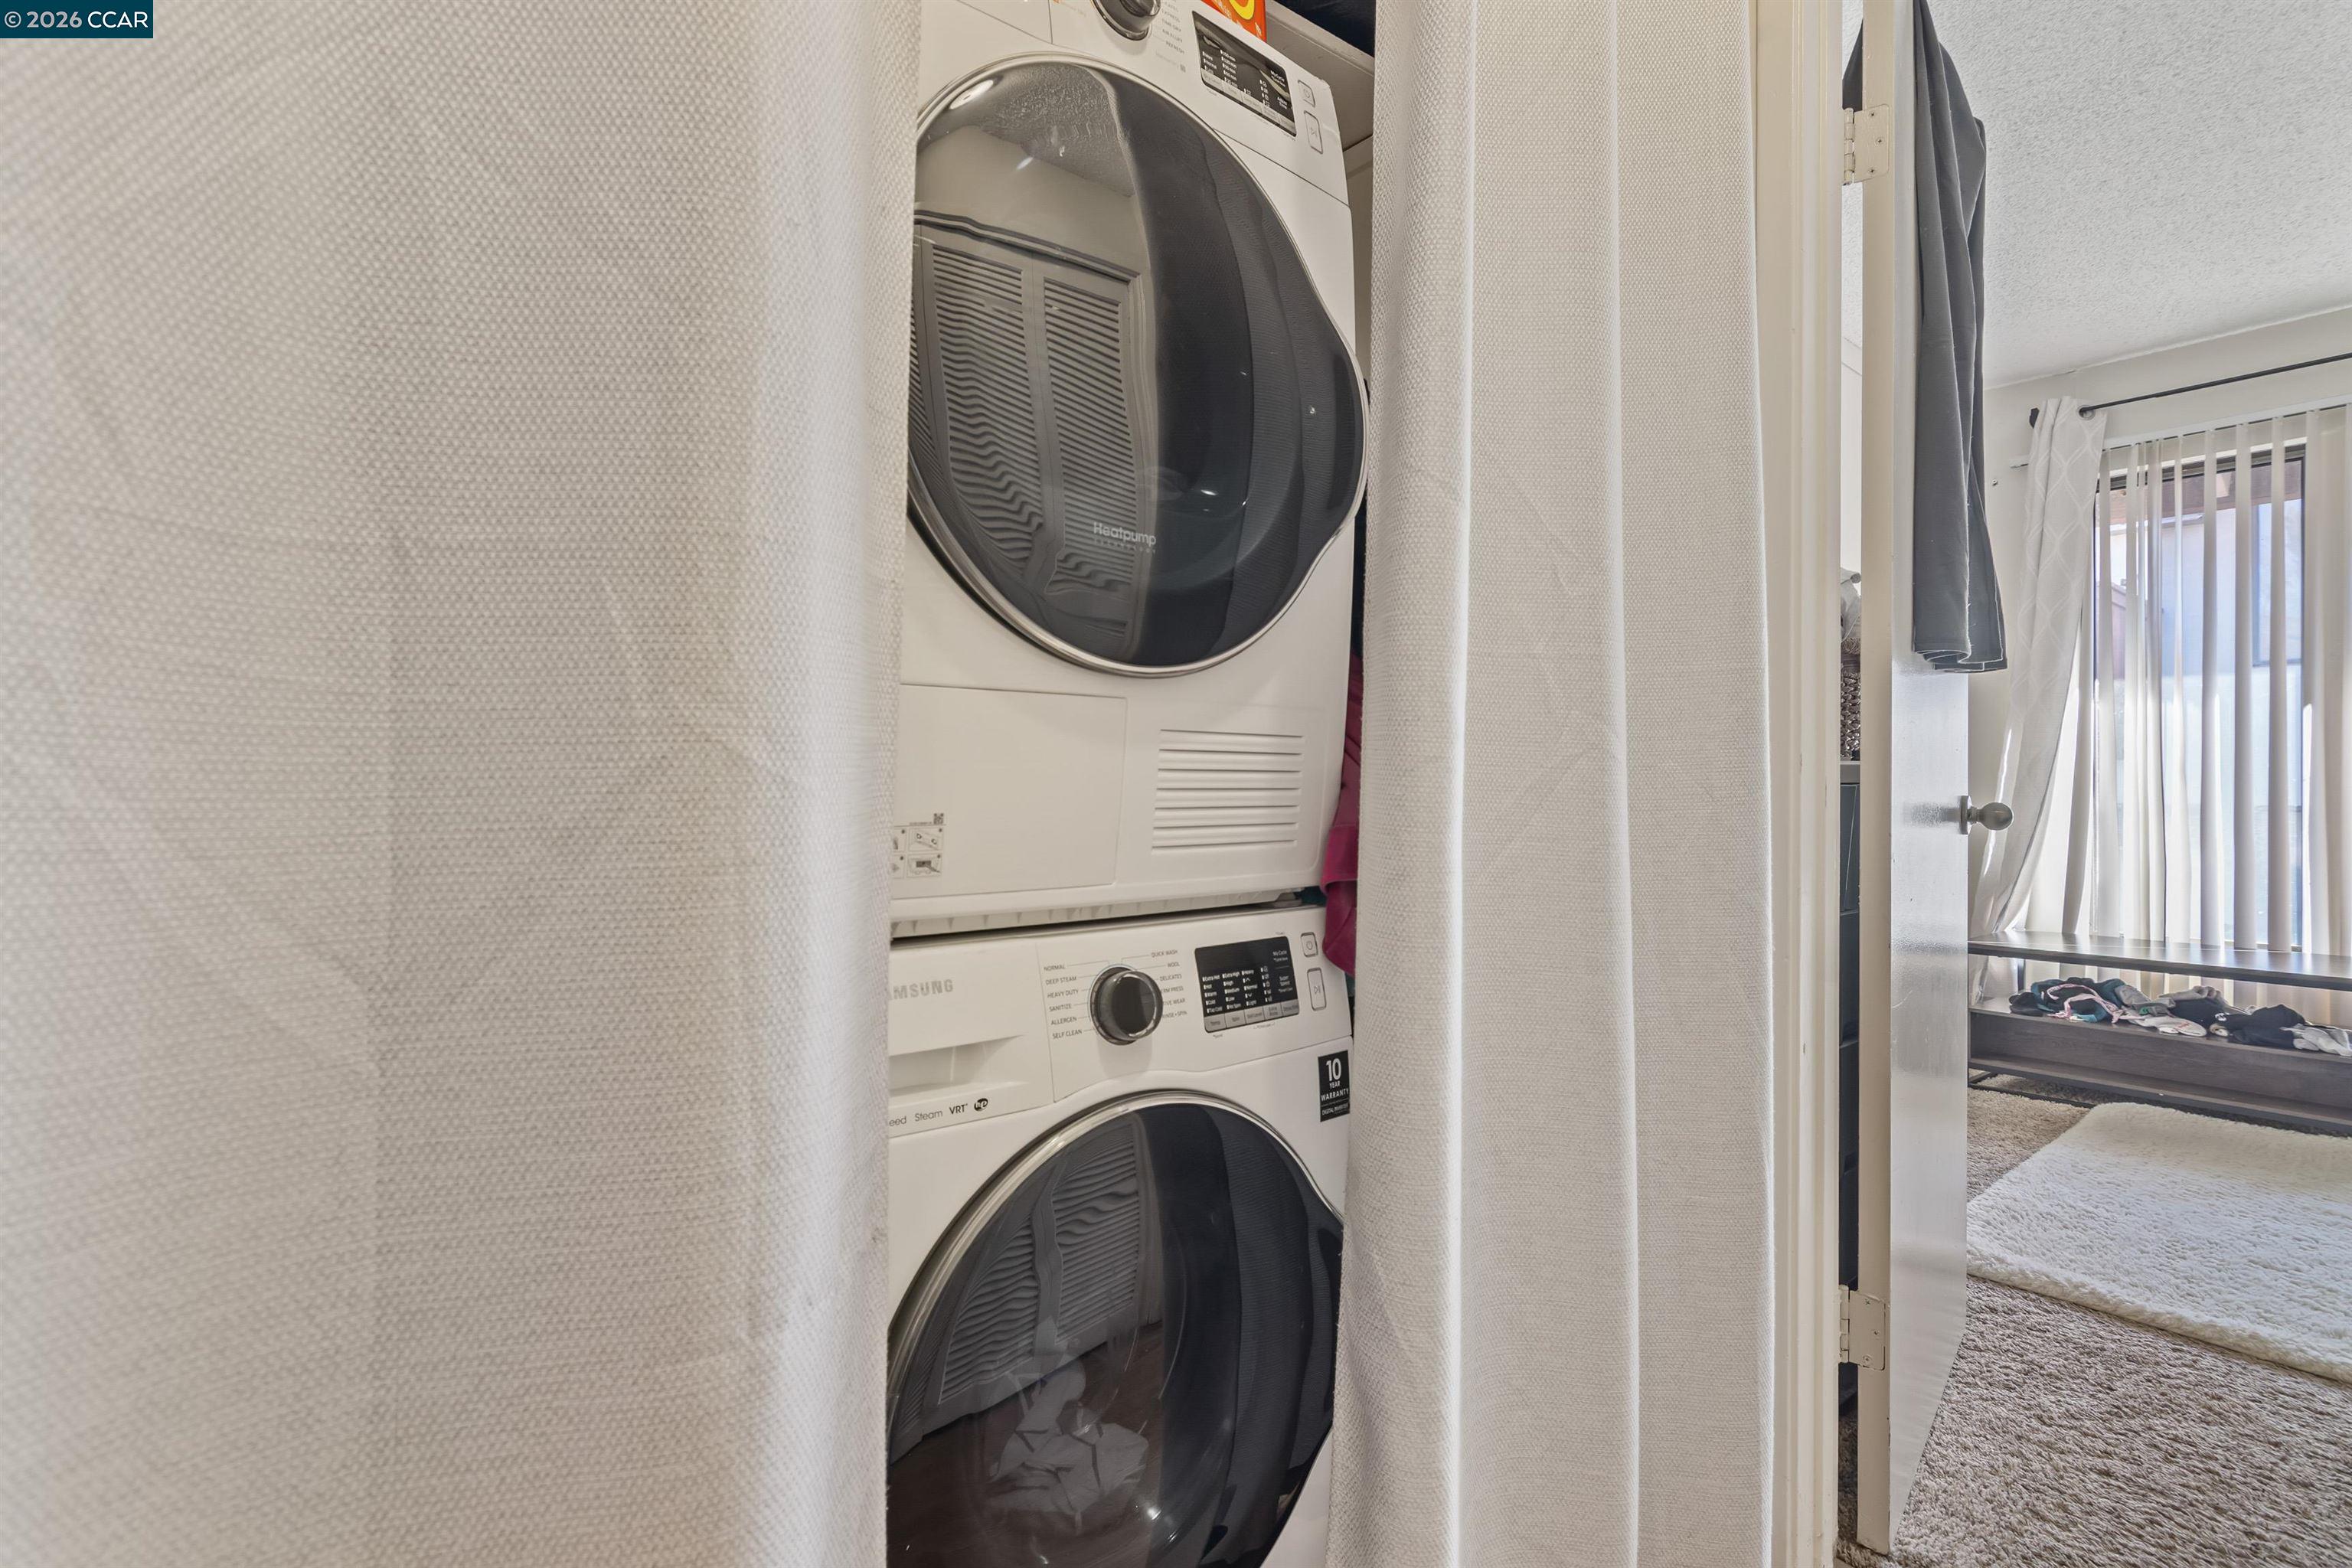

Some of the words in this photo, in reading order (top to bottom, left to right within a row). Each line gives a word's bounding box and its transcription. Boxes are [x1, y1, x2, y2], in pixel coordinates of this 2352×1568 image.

[1093, 521, 1157, 547] Heatpump
[888, 978, 953, 1000] MSUNG
[1049, 1003, 1072, 1012] SANITIZE
[1050, 1016, 1077, 1025] ALLERGEN
[1325, 1058, 1342, 1082] 10
[1329, 1080, 1341, 1089] YEAR
[1321, 1087, 1349, 1102] WARRANTY
[914, 1110, 943, 1122] Steam
